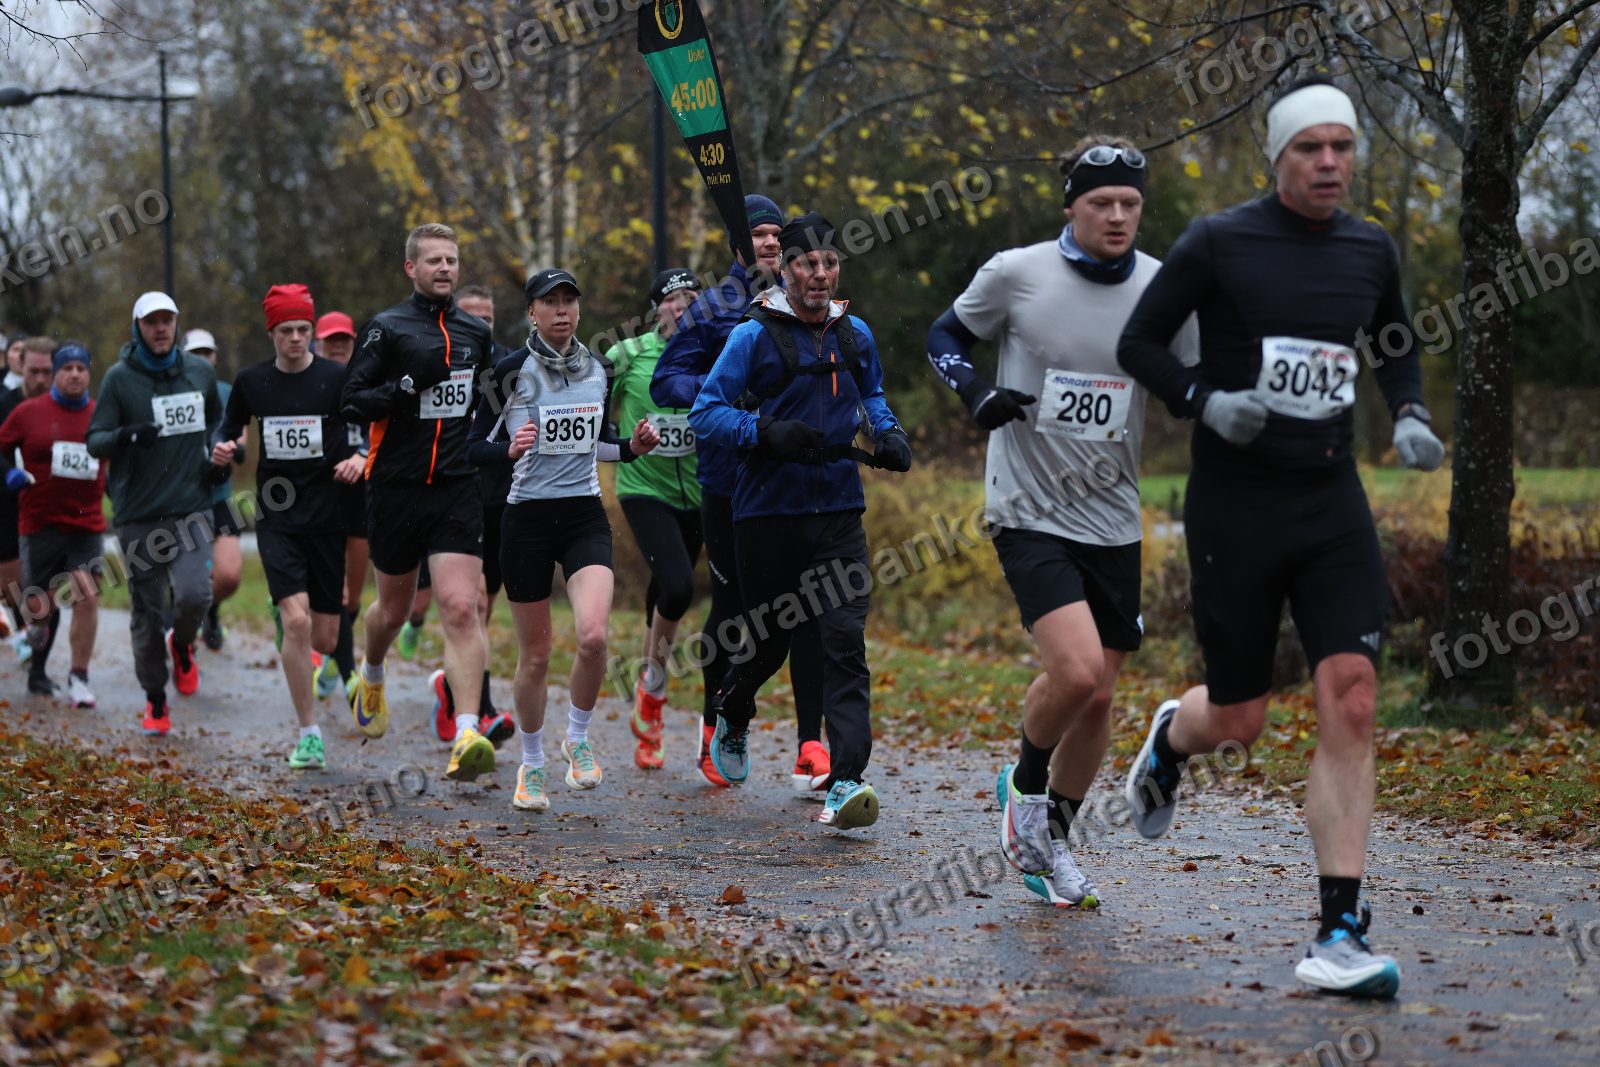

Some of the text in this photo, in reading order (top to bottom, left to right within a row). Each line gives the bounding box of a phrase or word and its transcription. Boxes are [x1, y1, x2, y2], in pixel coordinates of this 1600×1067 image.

[670, 76, 717, 114] 45:00
[699, 142, 725, 167] 4:30
[1053, 376, 1127, 390] NORGESTESTEN
[1268, 359, 1345, 401] 3042
[432, 383, 466, 408] 385
[164, 404, 196, 426] 562
[545, 406, 599, 416] NORGESTESTEN
[1056, 390, 1112, 426] 280
[275, 428, 310, 449] 165
[545, 416, 596, 442] 9361
[659, 426, 695, 448] 536
[61, 452, 89, 471] 824
